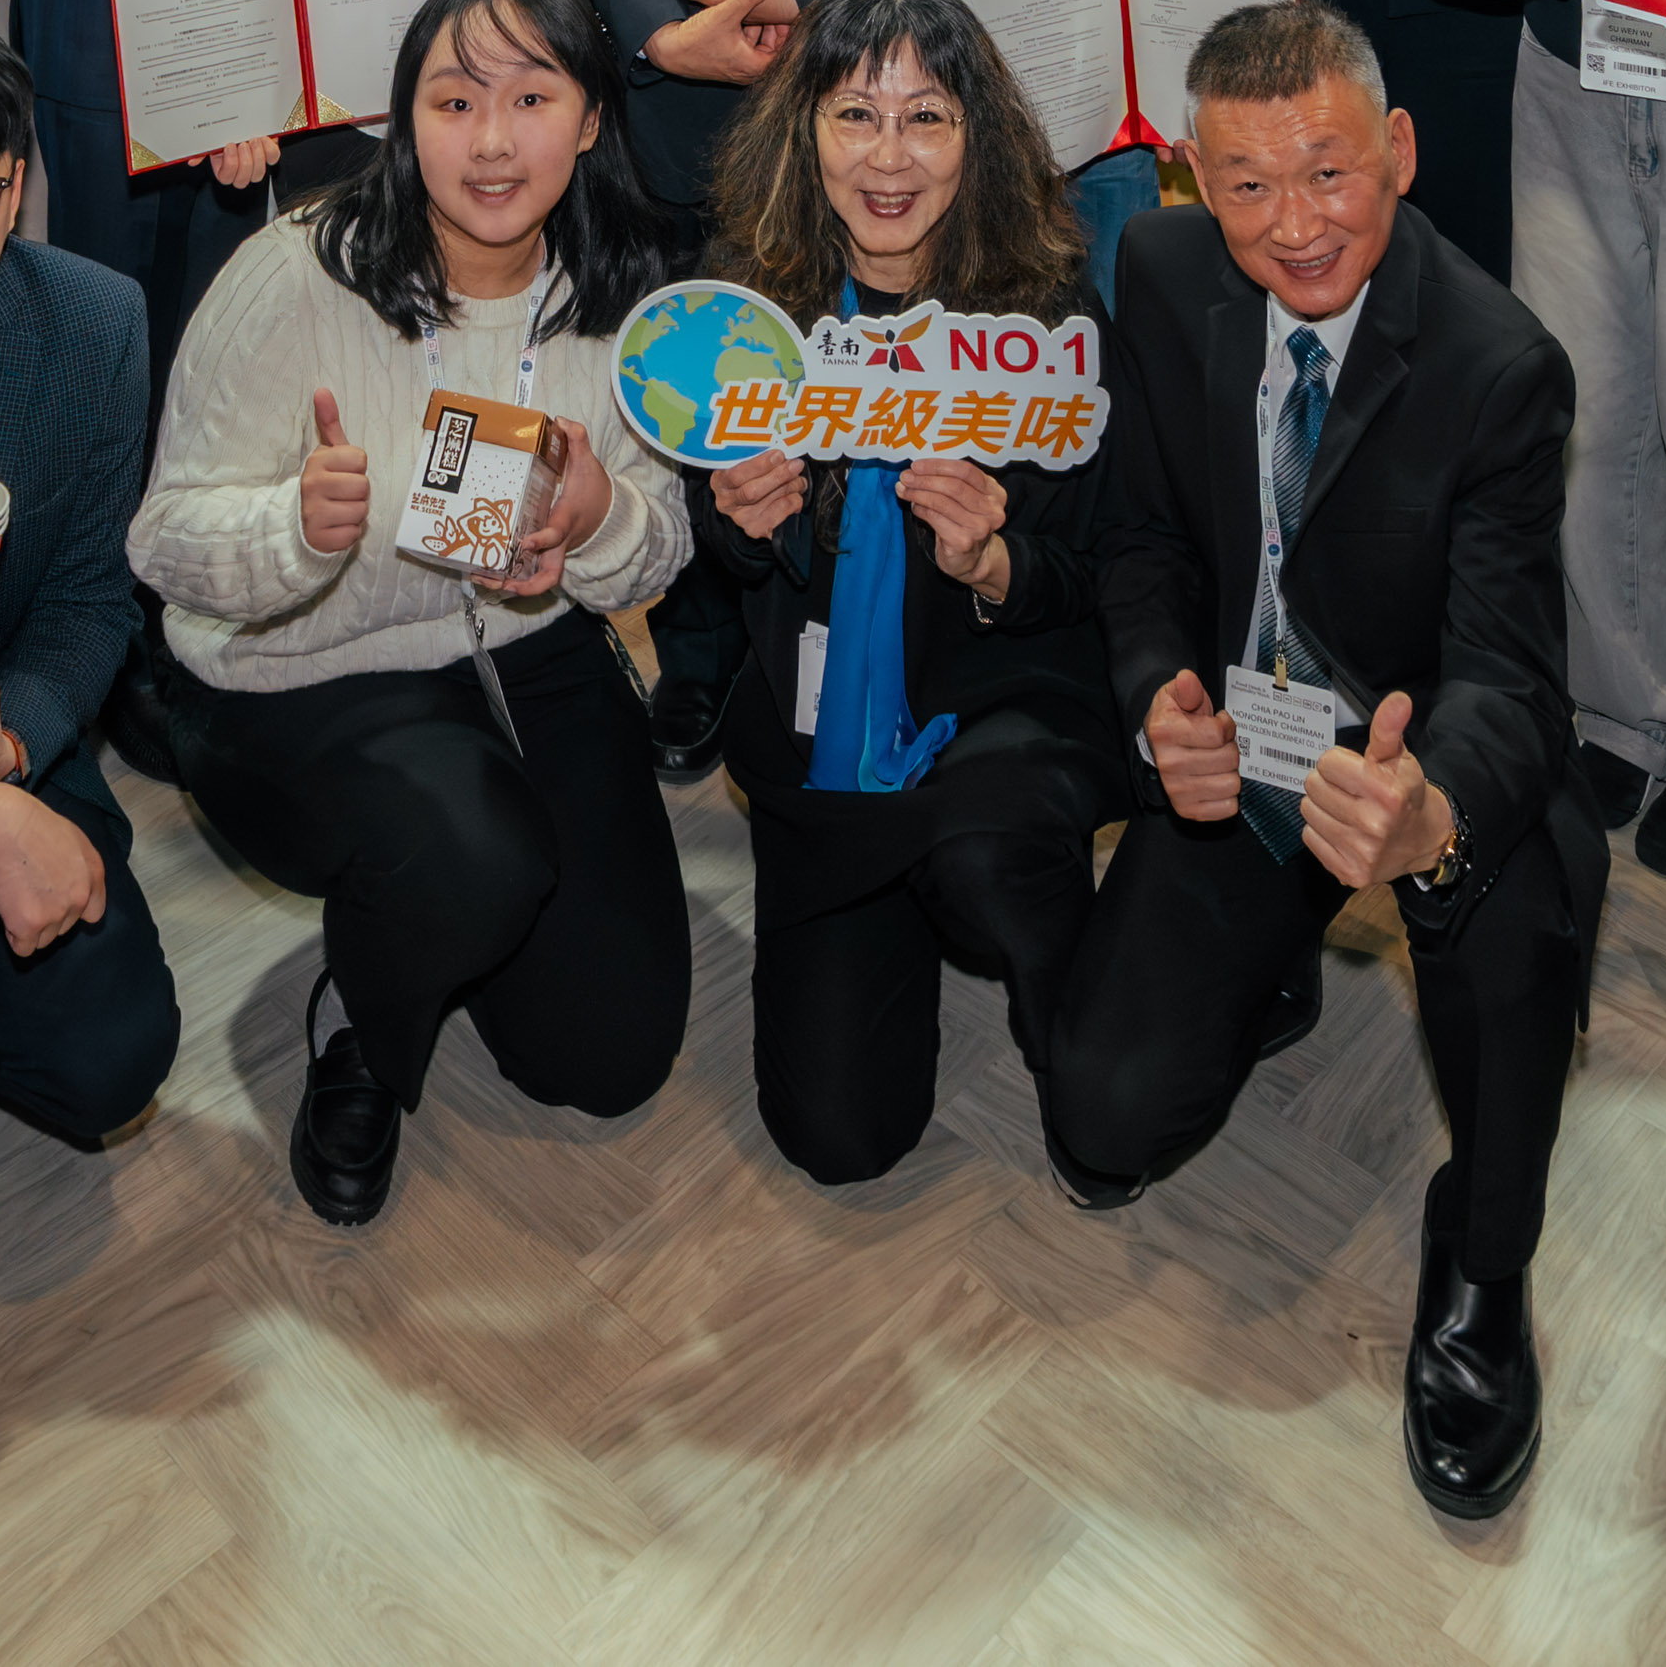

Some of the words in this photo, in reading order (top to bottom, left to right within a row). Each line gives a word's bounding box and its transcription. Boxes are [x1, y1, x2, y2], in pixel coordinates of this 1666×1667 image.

[1609, 35, 1650, 47] CHAIRMAN
[1616, 81, 1656, 93] EXHIBITOR
[817, 329, 860, 356] 臺南
[949, 328, 1087, 376] NO.1
[822, 358, 858, 366] TAINAN
[710, 381, 1097, 459] 世界級美味
[411, 492, 447, 510] 芝麻先生
[1251, 703, 1271, 714] CHIA
[1273, 709, 1290, 720] PAO
[1292, 714, 1306, 724] LIN
[1232, 709, 1279, 727] HONORARY
[1280, 722, 1325, 740] CHAIRMAN
[1247, 765, 1261, 775] IFE
